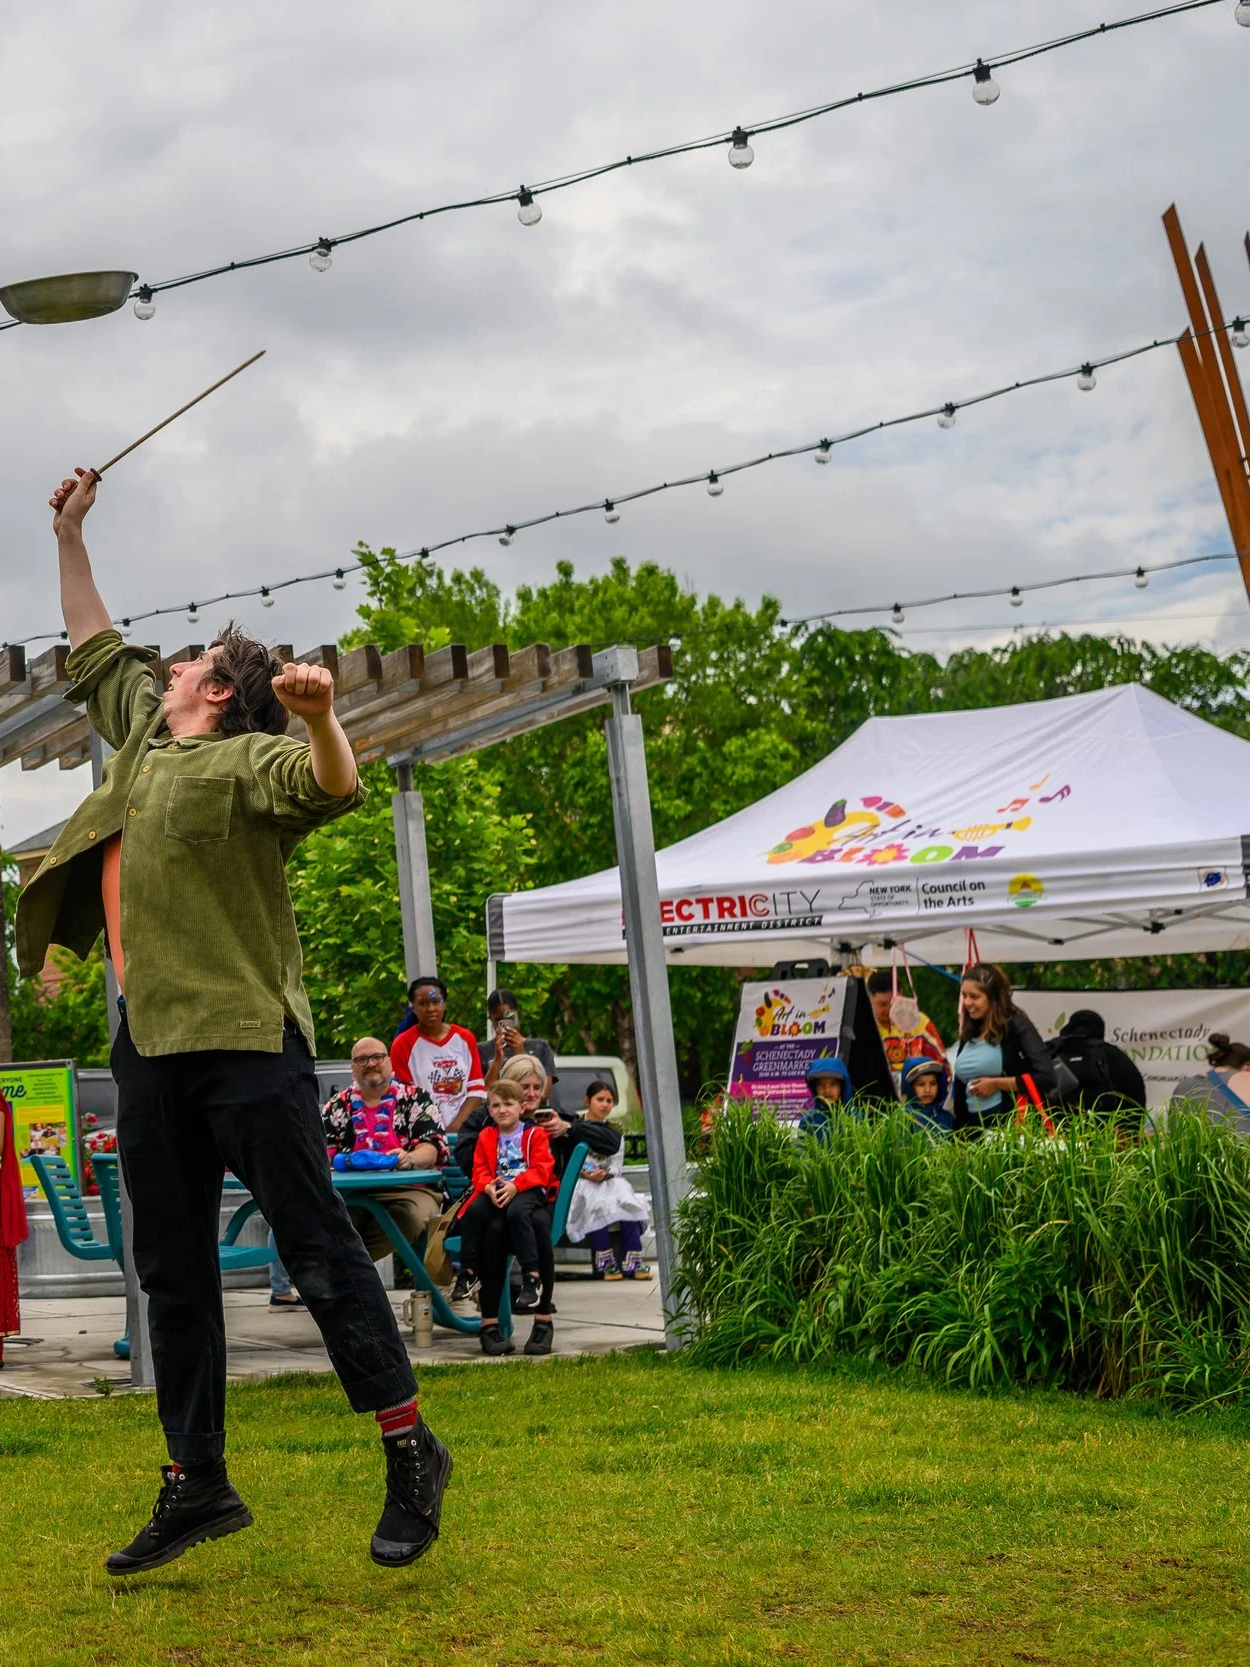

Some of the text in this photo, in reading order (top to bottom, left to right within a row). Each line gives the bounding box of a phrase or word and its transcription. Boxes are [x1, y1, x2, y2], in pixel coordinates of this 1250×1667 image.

[797, 843, 1006, 866] BLOOM
[869, 883, 912, 895] NEW YORK
[921, 879, 986, 896] Council on
[622, 888, 822, 926] ECTRICITY
[923, 894, 975, 909] the Arts
[666, 917, 821, 936] ENTERTAINMENT DISTRICT
[773, 1006, 807, 1021] Art in
[770, 1021, 826, 1036] BLOOM
[1112, 1024, 1211, 1042] Schenectady
[755, 1050, 816, 1061] SCHENECTADY
[1131, 1044, 1209, 1061] NDATIO
